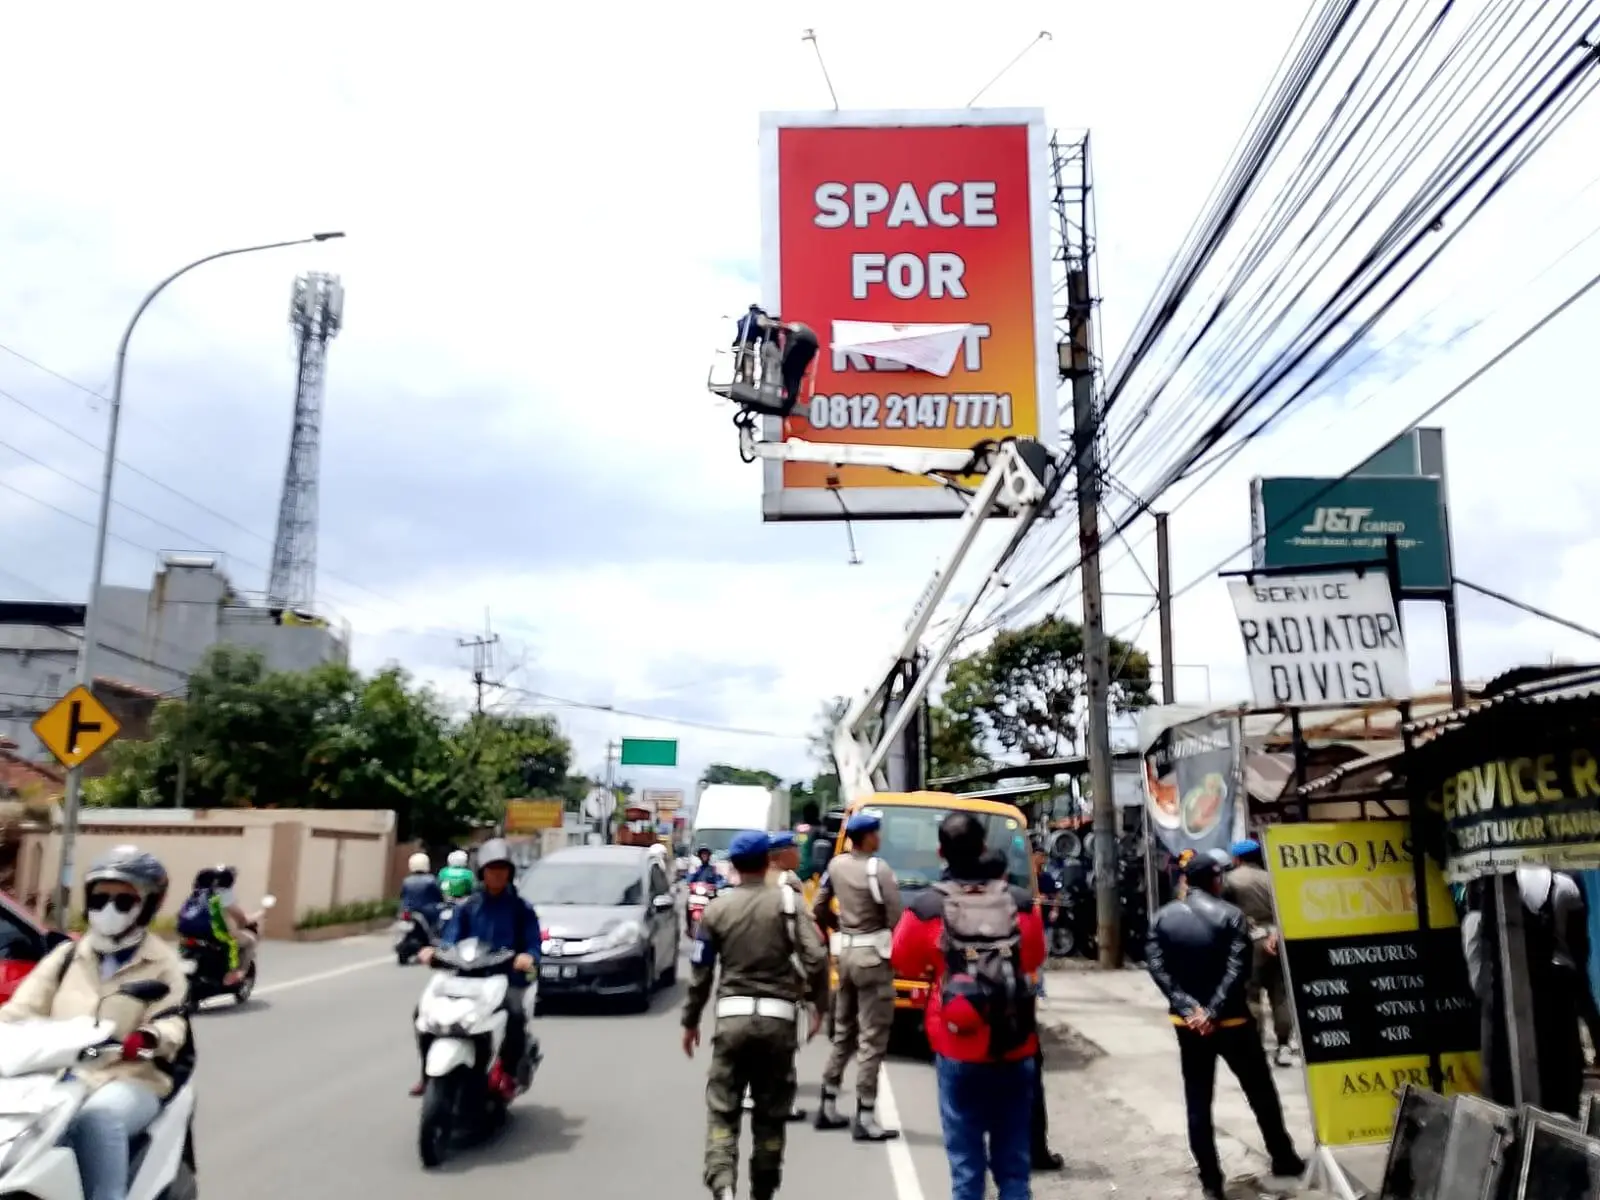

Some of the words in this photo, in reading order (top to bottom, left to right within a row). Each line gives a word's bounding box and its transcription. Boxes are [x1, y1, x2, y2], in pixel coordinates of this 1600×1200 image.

[814, 182, 998, 228] SPACE
[851, 253, 968, 299] FOR
[809, 394, 880, 429] 0812
[885, 394, 954, 429] 2147
[954, 394, 1013, 428] 7771
[1302, 507, 1374, 532] J&T
[1253, 583, 1350, 603] SERVICE
[1240, 612, 1401, 655] RADIATOR
[1270, 660, 1389, 701] DIVISI
[1279, 841, 1358, 869] BIRO
[1364, 838, 1416, 872] JAS
[1327, 944, 1418, 968] MENGURUS
[1316, 1004, 1344, 1023] SIM
[1385, 1025, 1413, 1041] KIR
[1342, 1071, 1389, 1096] ASA
